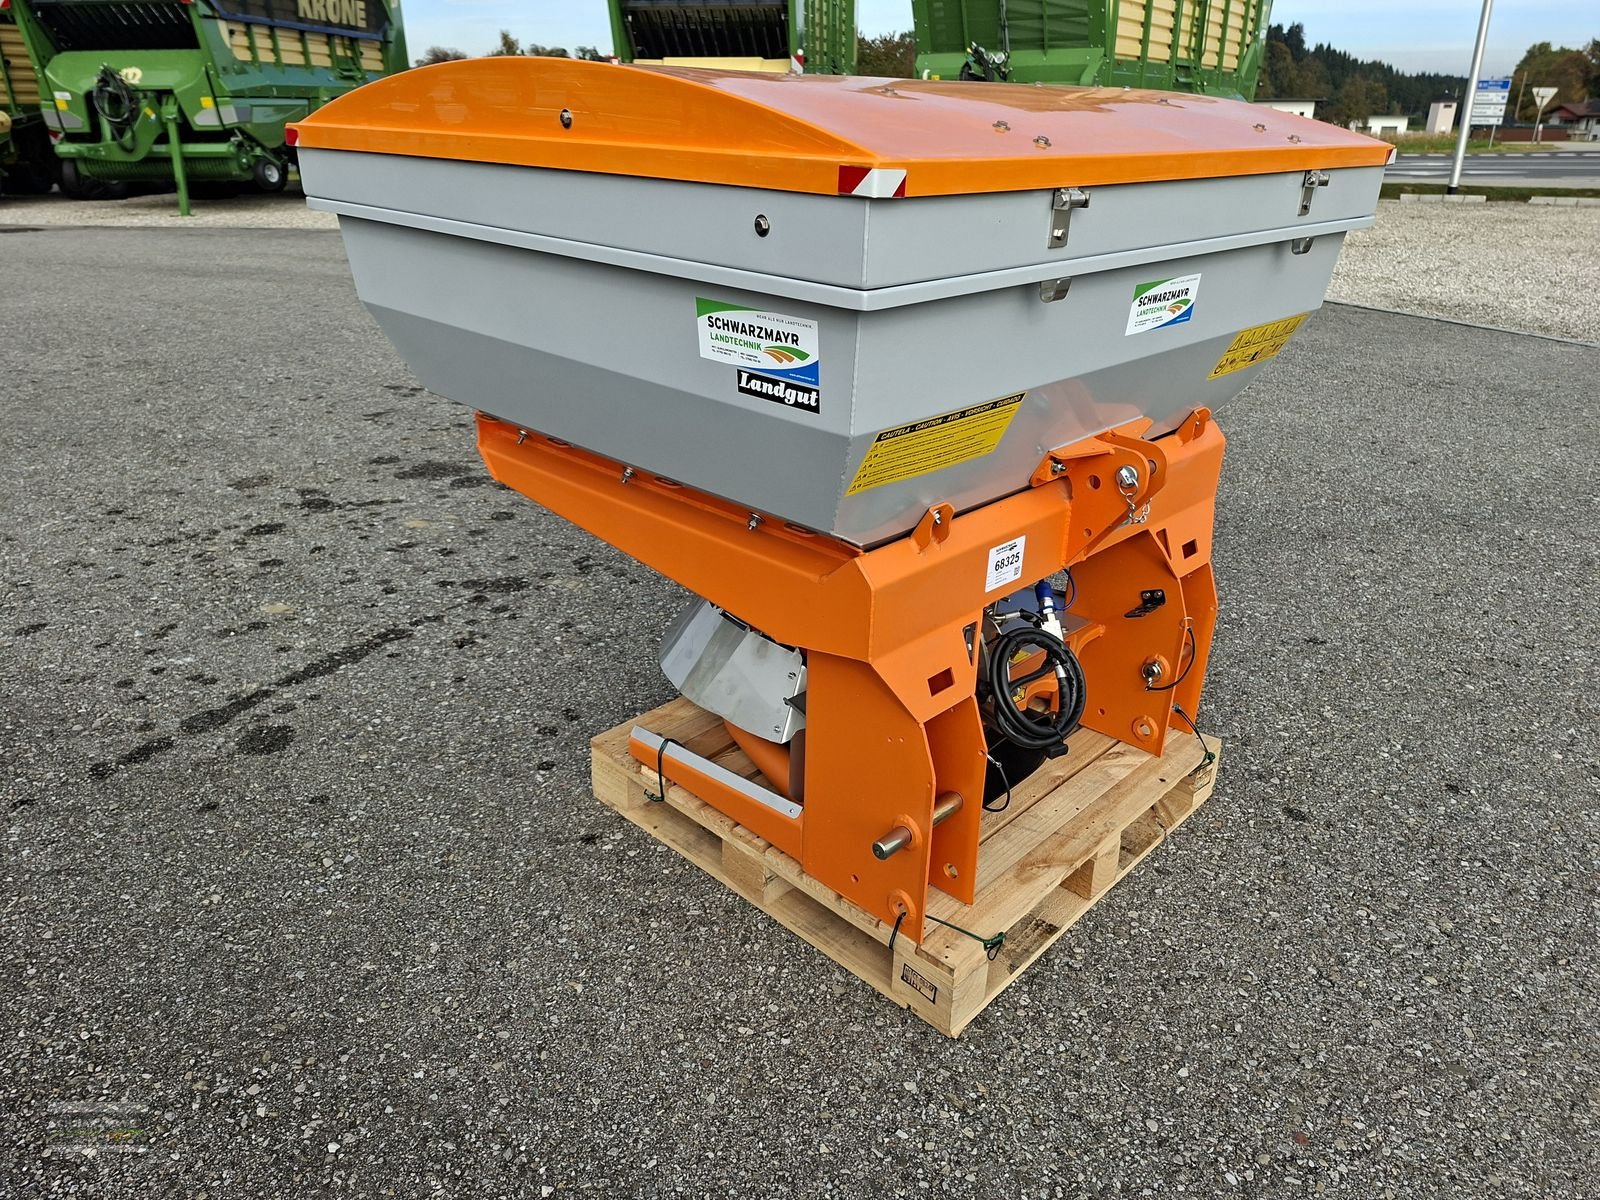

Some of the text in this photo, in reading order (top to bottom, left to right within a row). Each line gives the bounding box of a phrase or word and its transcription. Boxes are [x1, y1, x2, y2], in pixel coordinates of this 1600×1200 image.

[297, 0, 367, 28] KRONE
[1138, 287, 1190, 307] SCHWARZMAYR
[1136, 305, 1167, 317] LANDTECHNIK
[707, 315, 800, 346] SCHWARZMAYR
[710, 332, 762, 351] LANDTECHNIK
[739, 371, 818, 406] Landgut
[880, 427, 911, 440] CAUTELA
[915, 417, 944, 431] CAUTION
[947, 412, 961, 422] AVIS
[965, 403, 994, 417] VORSICHT
[995, 551, 1020, 571] 68325
